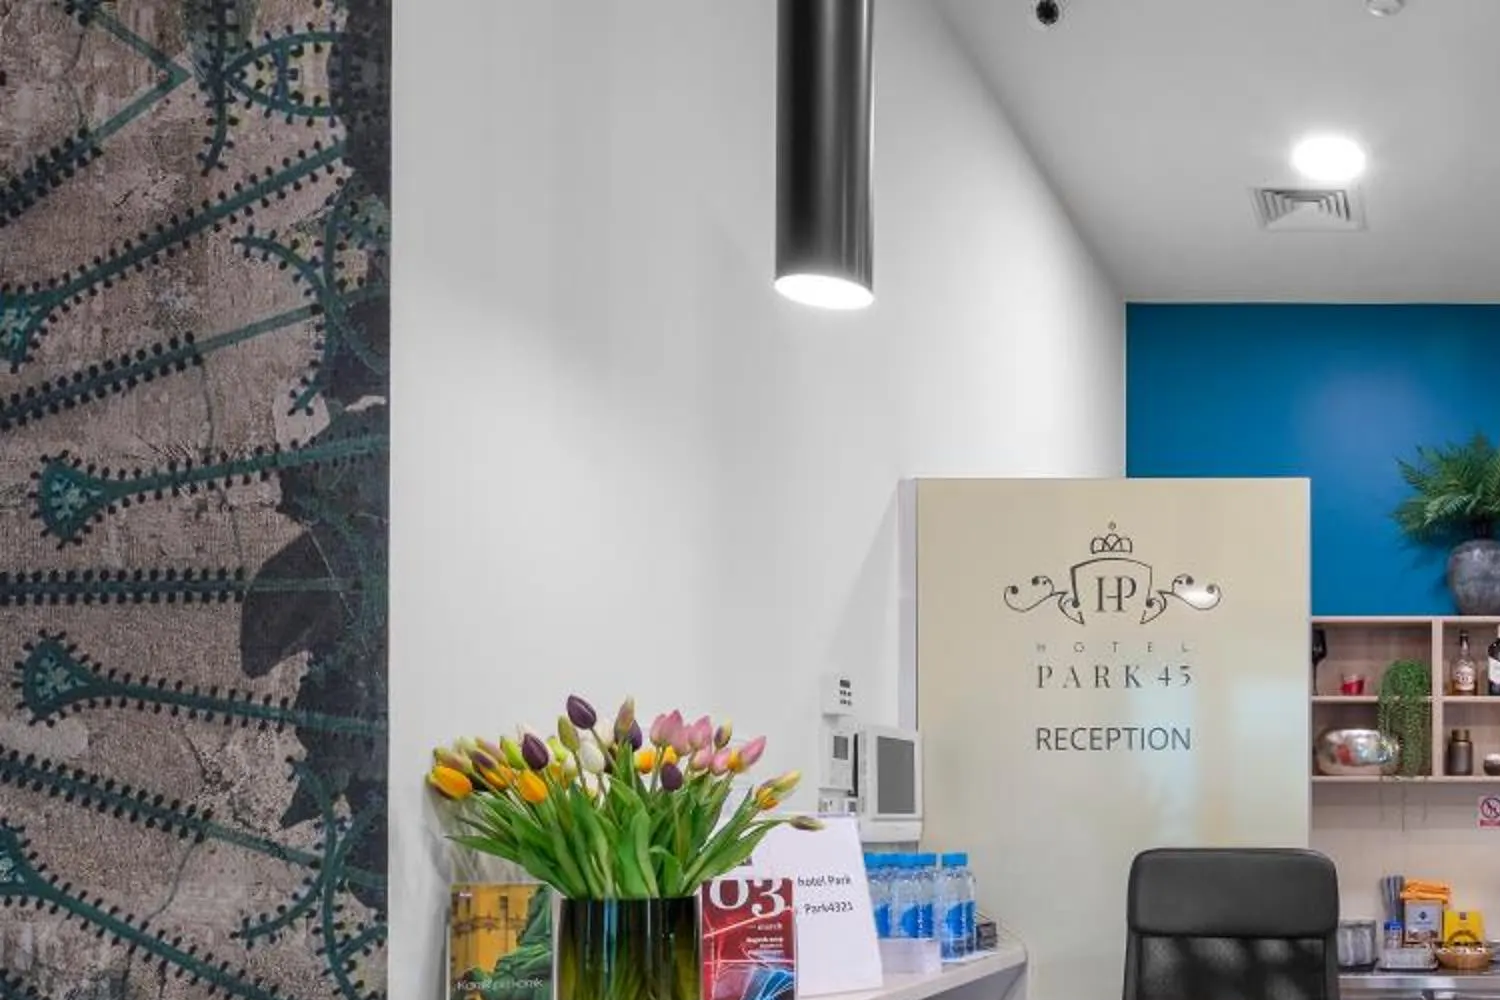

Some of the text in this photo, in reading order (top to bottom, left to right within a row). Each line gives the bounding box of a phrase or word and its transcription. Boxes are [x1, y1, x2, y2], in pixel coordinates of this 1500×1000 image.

[1036, 641, 1190, 653] HOTEL
[1036, 664, 1192, 689] PARK 45
[1036, 727, 1191, 751] RECEPTION
